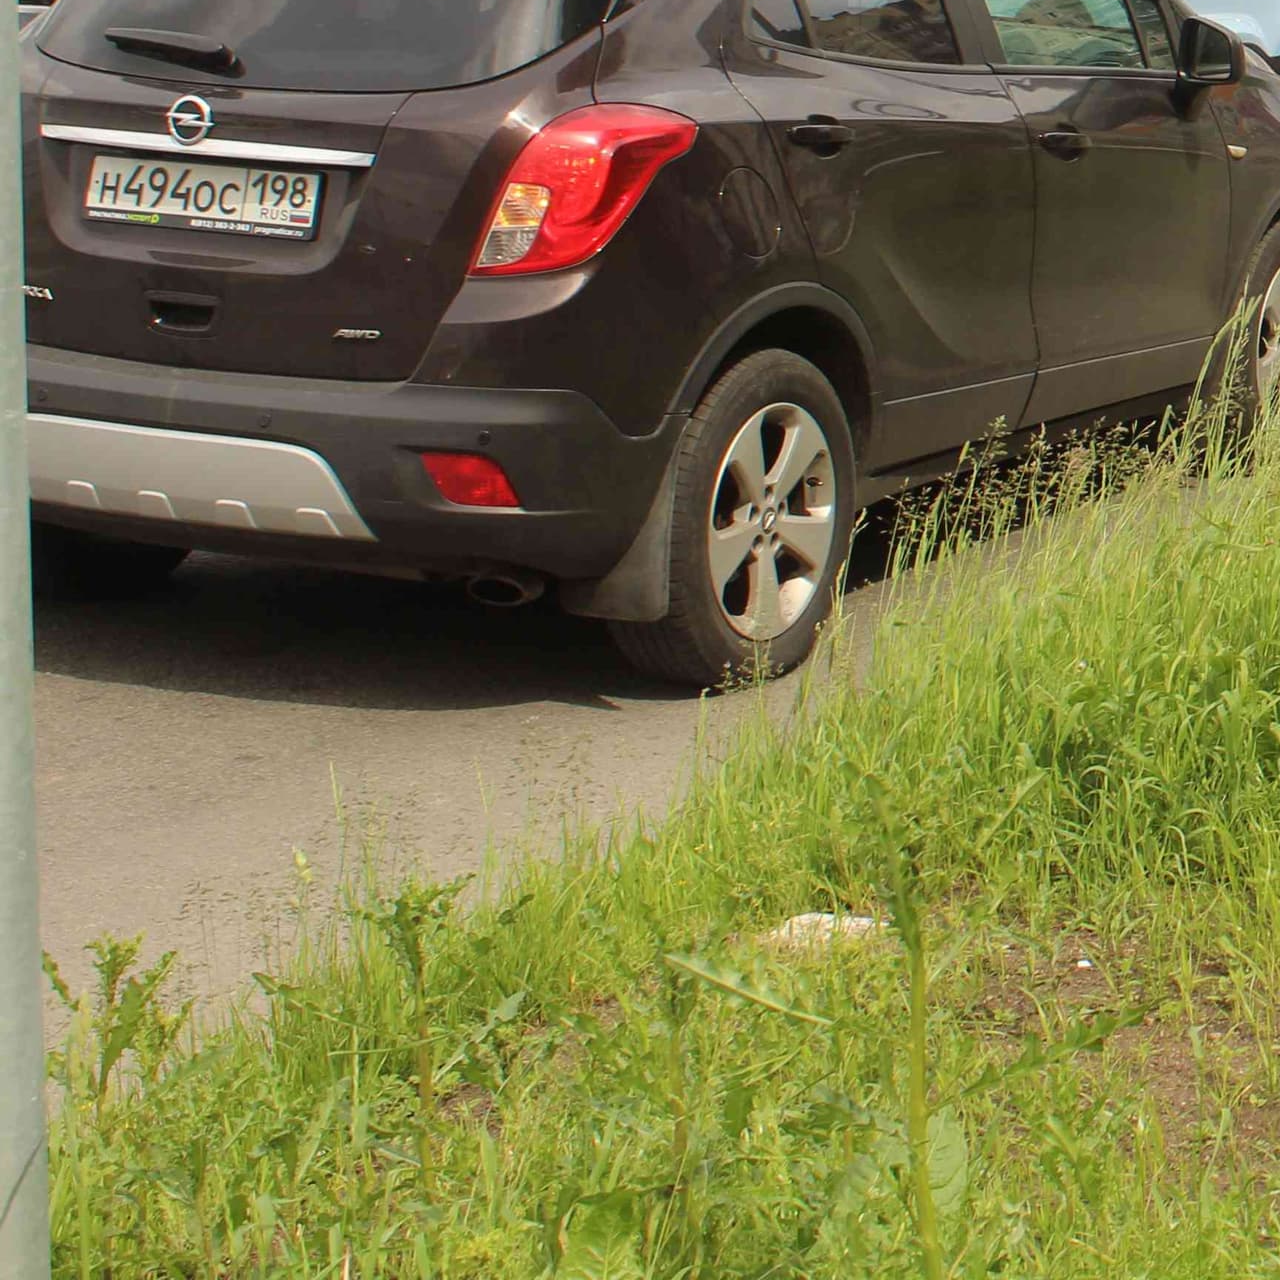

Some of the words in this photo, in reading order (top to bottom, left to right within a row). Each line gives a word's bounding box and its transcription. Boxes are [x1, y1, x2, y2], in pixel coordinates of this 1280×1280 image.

[99, 164, 241, 216] Н494ОС
[252, 172, 309, 209] 198
[260, 207, 289, 221] RUS
